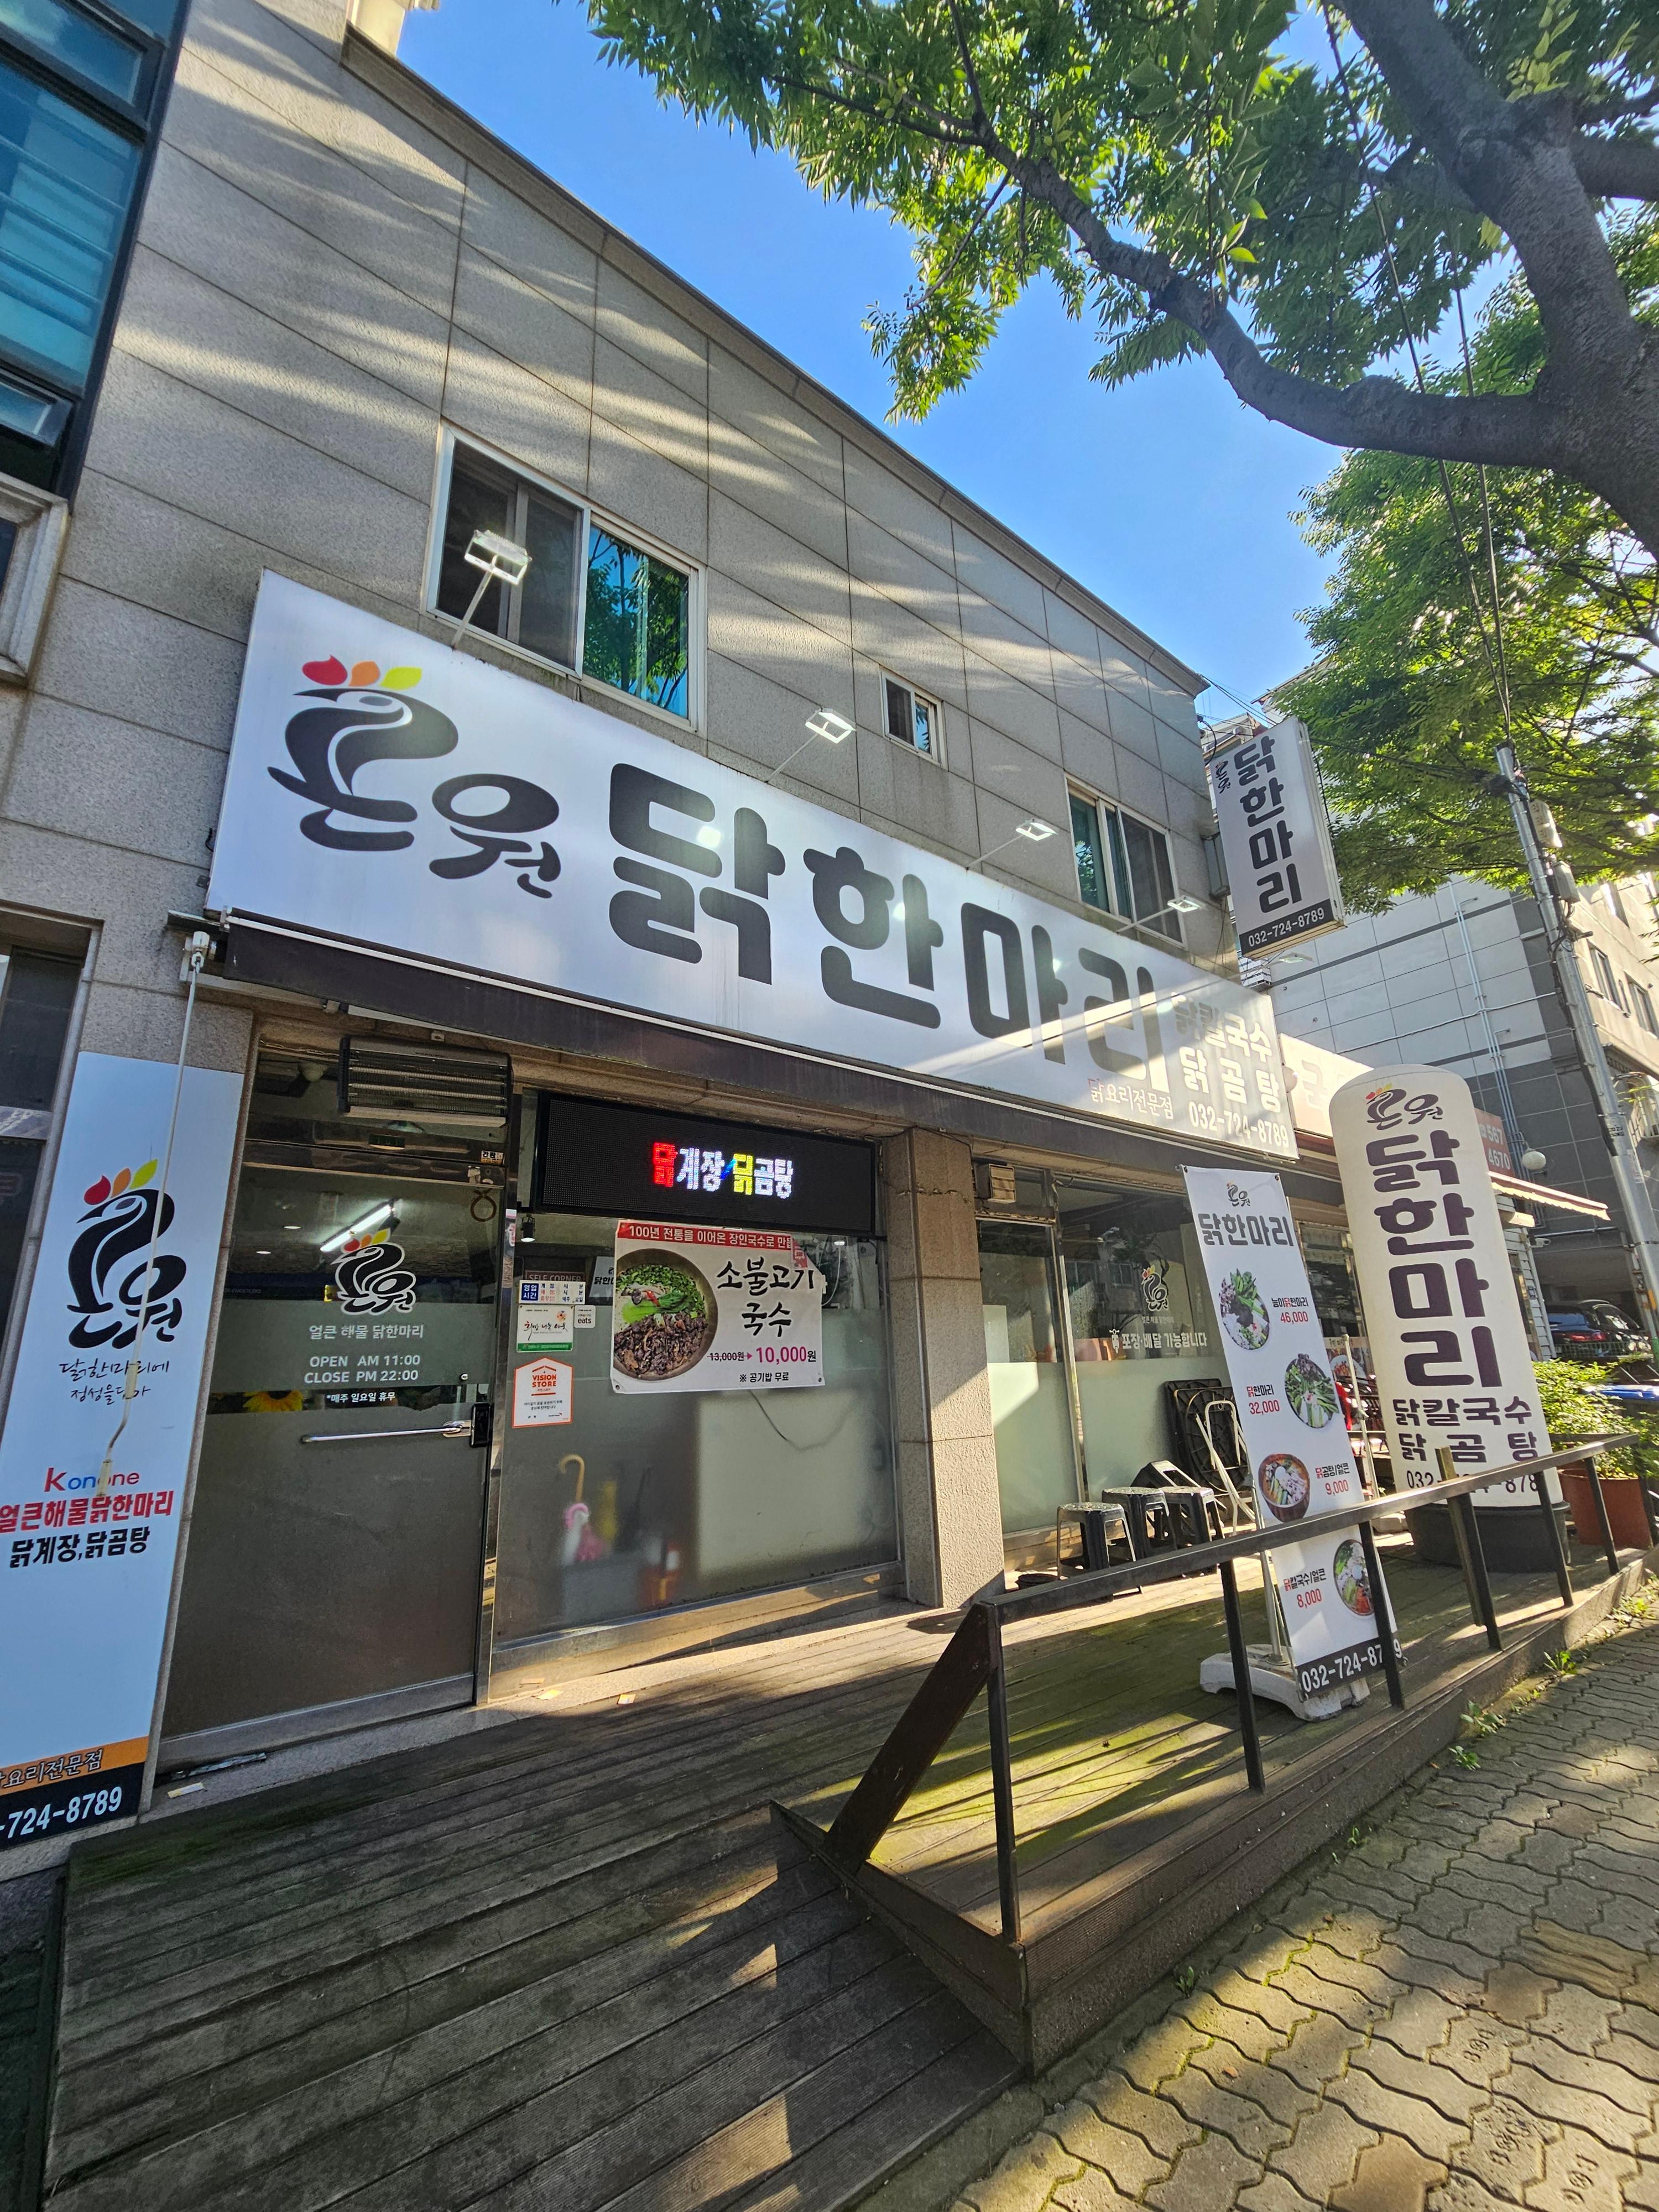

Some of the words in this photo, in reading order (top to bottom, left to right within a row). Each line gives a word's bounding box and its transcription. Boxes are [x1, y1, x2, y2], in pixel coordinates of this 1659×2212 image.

[1233, 735, 1302, 914] 닭한마리
[608, 763, 1170, 1094] 닭한마리
[1248, 907, 1325, 947] 032-724-8789
[1188, 1100, 1290, 1148] 032-724-8789
[1488, 1148, 1511, 1170] 4670
[629, 1225, 660, 1239] 100년
[663, 1227, 694, 1241] 전통을
[697, 1229, 726, 1244] 이어온
[729, 1232, 775, 1248] 장인국수로
[1197, 1213, 1294, 1247] 닭한마리
[1365, 1129, 1503, 1388] 닭한마리
[593, 1276, 614, 1285] 닭한
[716, 1256, 815, 1296] 소불고기
[1271, 1297, 1309, 1308] 능이닭한마리
[742, 1302, 791, 1337] 국수
[1280, 1311, 1309, 1324] 46,000
[309, 1324, 337, 1340] 얼큰
[372, 1324, 424, 1339] 닭한마리
[1164, 1332, 1207, 1348] 가능합니다
[309, 1356, 348, 1368] OPEN
[357, 1355, 380, 1366] AM
[383, 1354, 421, 1366] 11:00
[709, 1351, 745, 1361] 13,000원
[755, 1345, 817, 1365] 10,000원
[304, 1371, 351, 1384] CLOSE
[356, 1370, 378, 1382] PM
[379, 1369, 419, 1381] 22:00
[749, 1373, 773, 1383] 공기밥
[774, 1371, 790, 1382] 무료
[351, 1392, 377, 1402] 일요일
[379, 1391, 396, 1401] 휴무
[1246, 1384, 1275, 1397] 닭한마리
[1249, 1400, 1280, 1415] 32,000
[1392, 1396, 1532, 1427] 닭칼국수
[1315, 1463, 1350, 1479] 닭곰탕/얼큰
[1324, 1479, 1349, 1495] 9,000
[1283, 1568, 1327, 1592] 닭칼국수/얼큰
[1297, 1588, 1322, 1609] 8,000
[1301, 1638, 1402, 1693] 032-724-879
